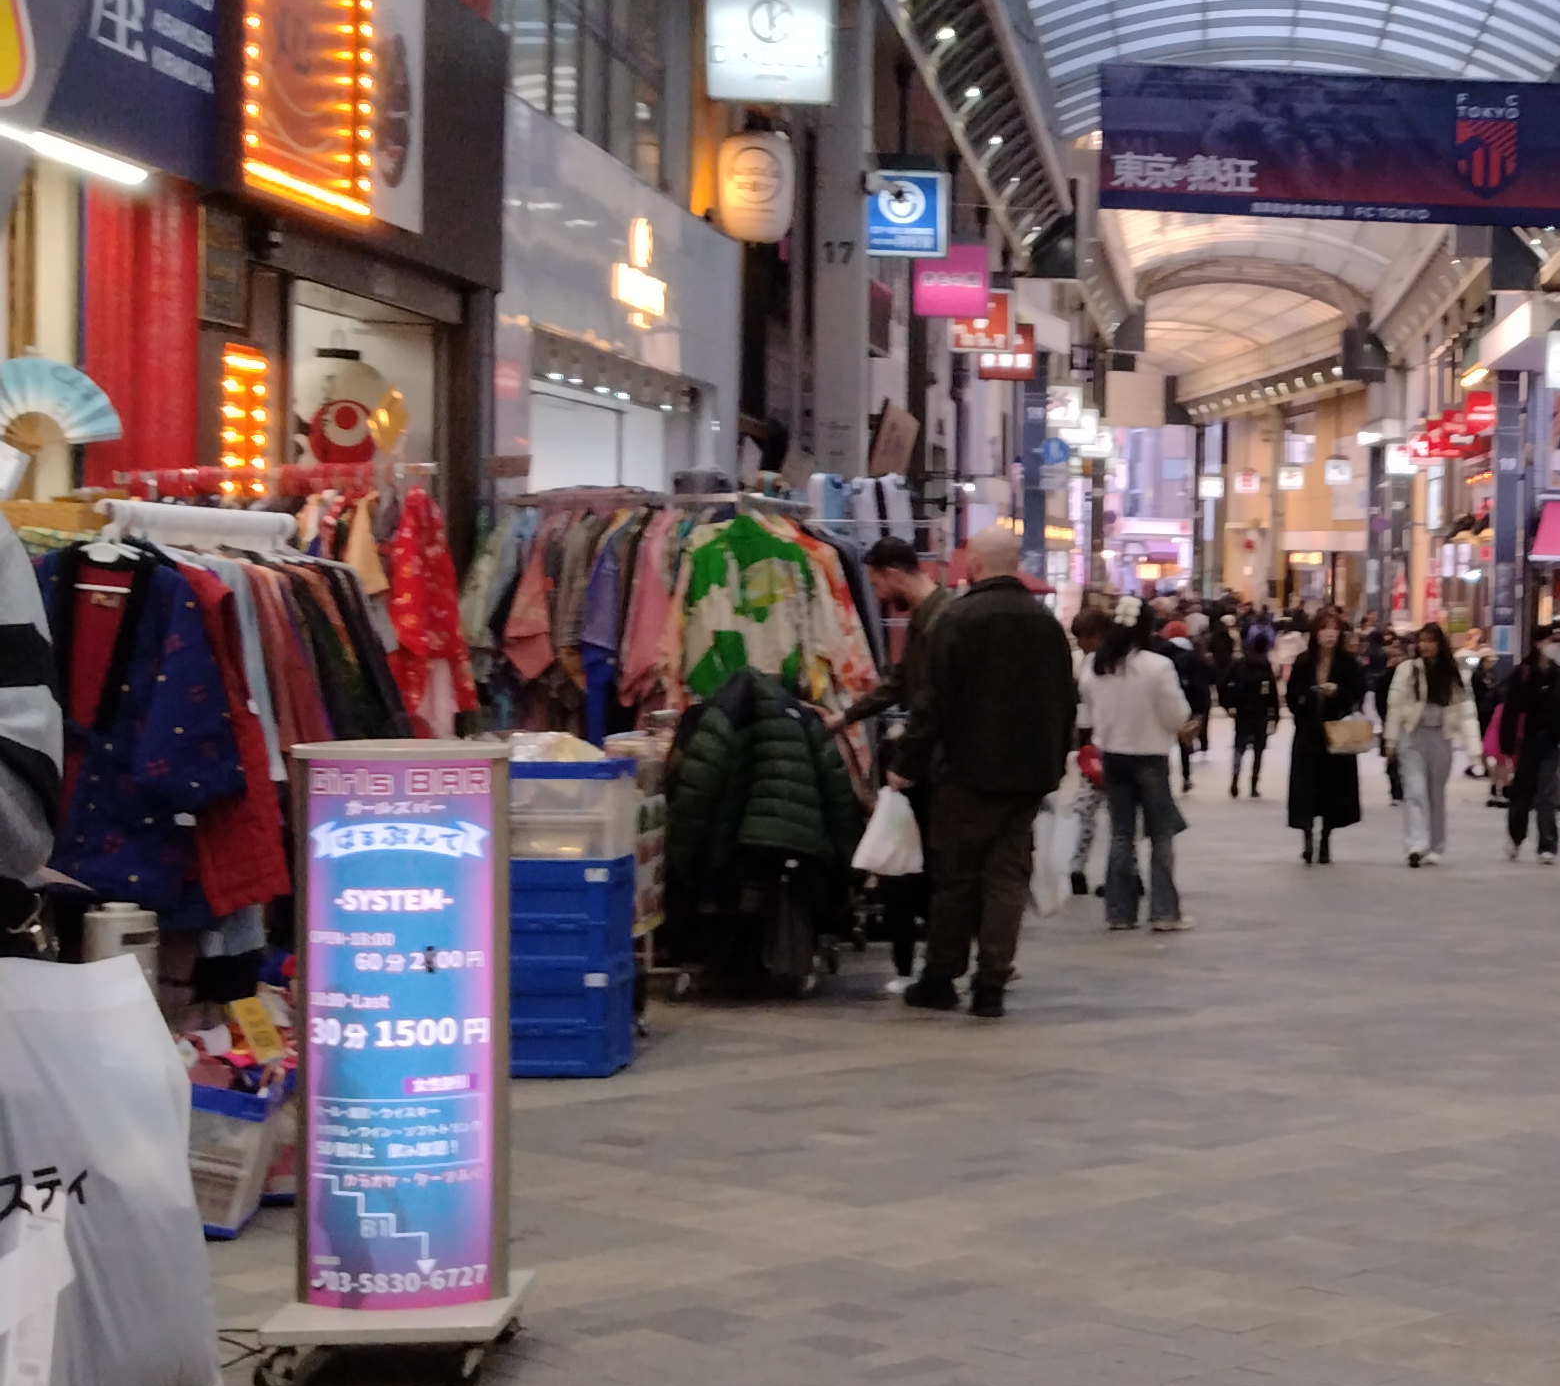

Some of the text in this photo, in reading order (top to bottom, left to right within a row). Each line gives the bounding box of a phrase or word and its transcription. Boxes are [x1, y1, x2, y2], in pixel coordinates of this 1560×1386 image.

[1456, 93, 1519, 106] F C
[1456, 105, 1520, 119] TOKYO
[823, 241, 854, 264] 17
[309, 767, 490, 795] Girls BAR
[355, 950, 485, 972] 60分 200円
[310, 1017, 368, 1049] 30分
